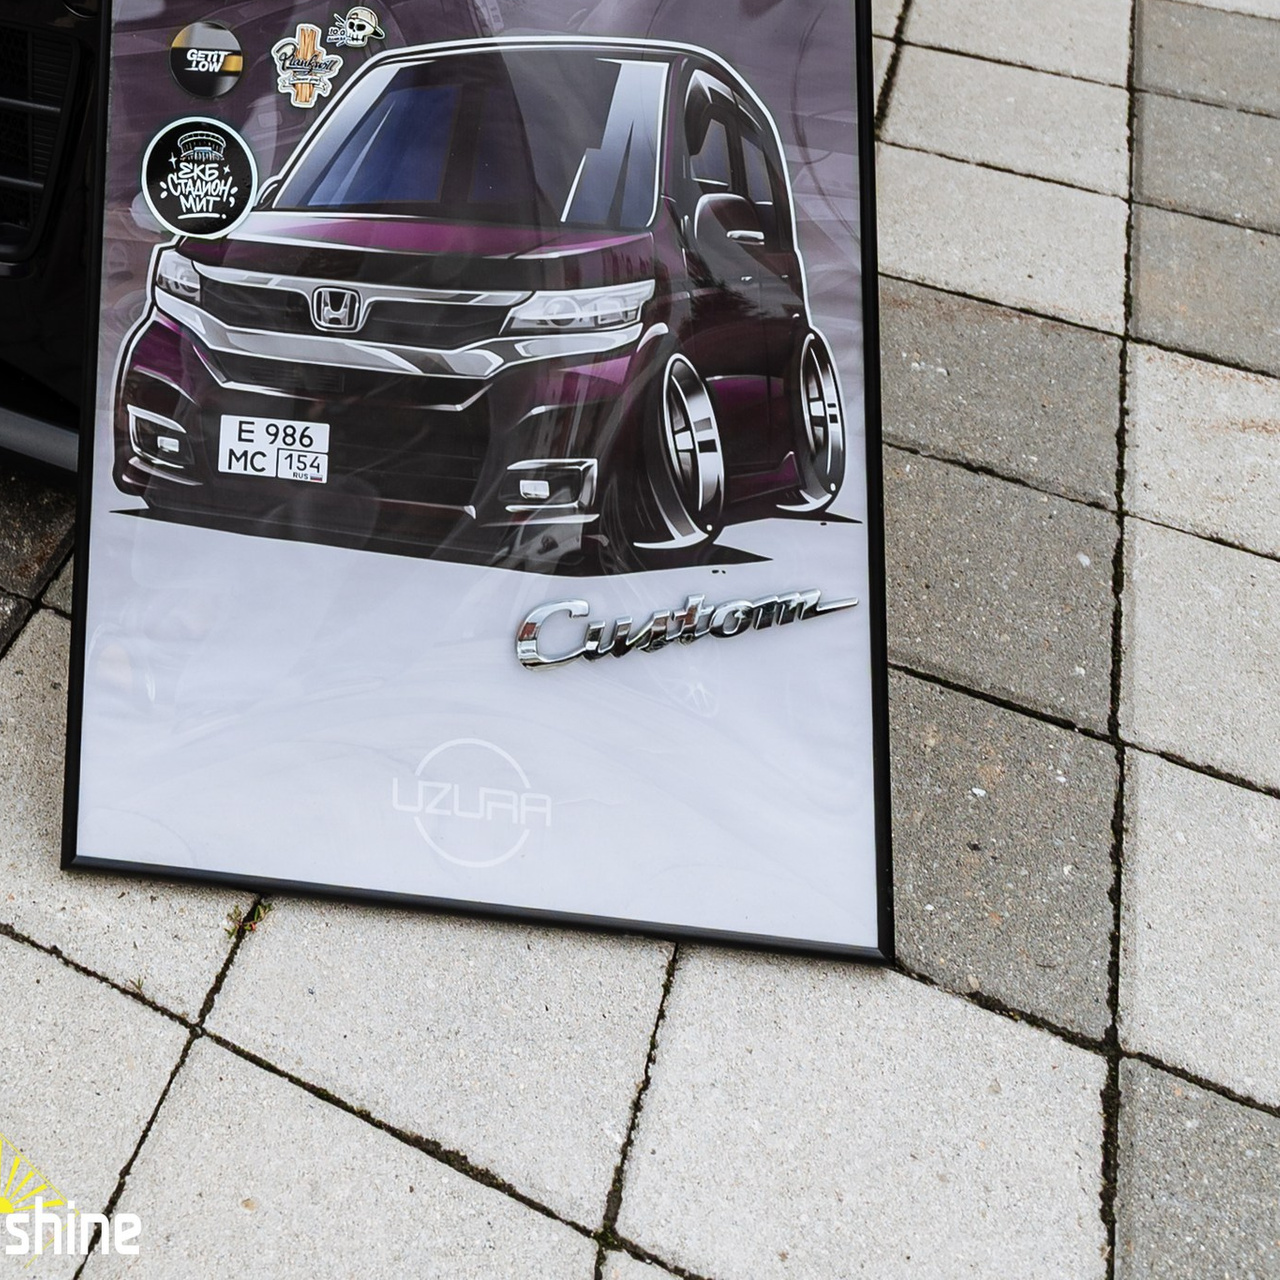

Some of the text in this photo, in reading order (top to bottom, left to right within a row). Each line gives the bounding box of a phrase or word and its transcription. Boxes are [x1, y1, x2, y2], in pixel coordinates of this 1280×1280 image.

[184, 60, 223, 73] LOW
[178, 162, 219, 181] ЕКБ
[180, 195, 220, 213] МИТ
[238, 421, 313, 448] E 986
[228, 448, 320, 473] MC 154
[292, 472, 308, 480] RUS
[516, 589, 859, 671] Custom
